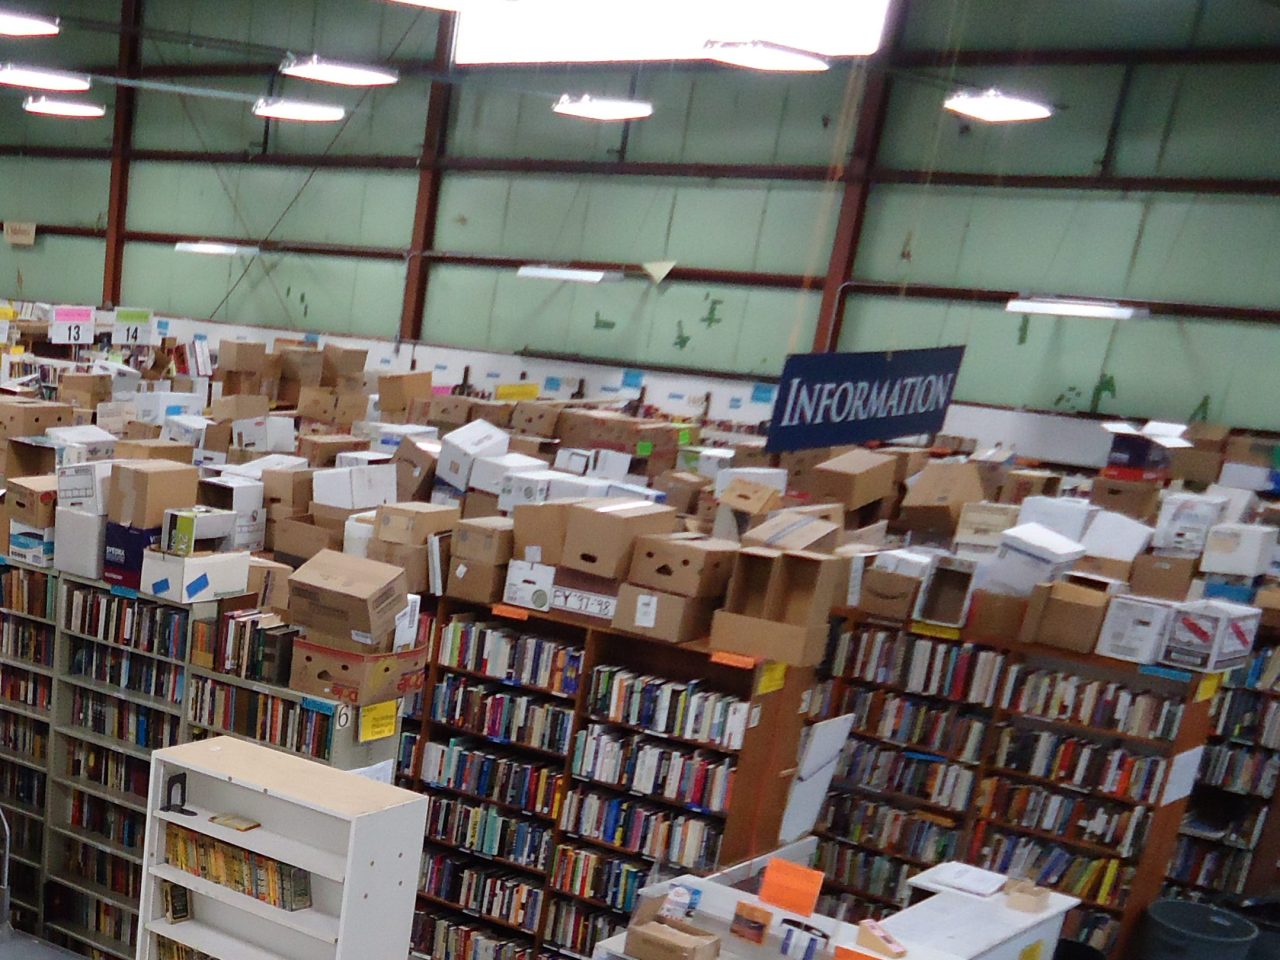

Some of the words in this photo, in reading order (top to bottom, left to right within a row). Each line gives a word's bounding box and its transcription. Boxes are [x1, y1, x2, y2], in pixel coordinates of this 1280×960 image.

[68, 325, 81, 342] 13
[126, 327, 138, 342] 14
[781, 373, 954, 427] INFORMATION
[338, 704, 349, 727] 6
